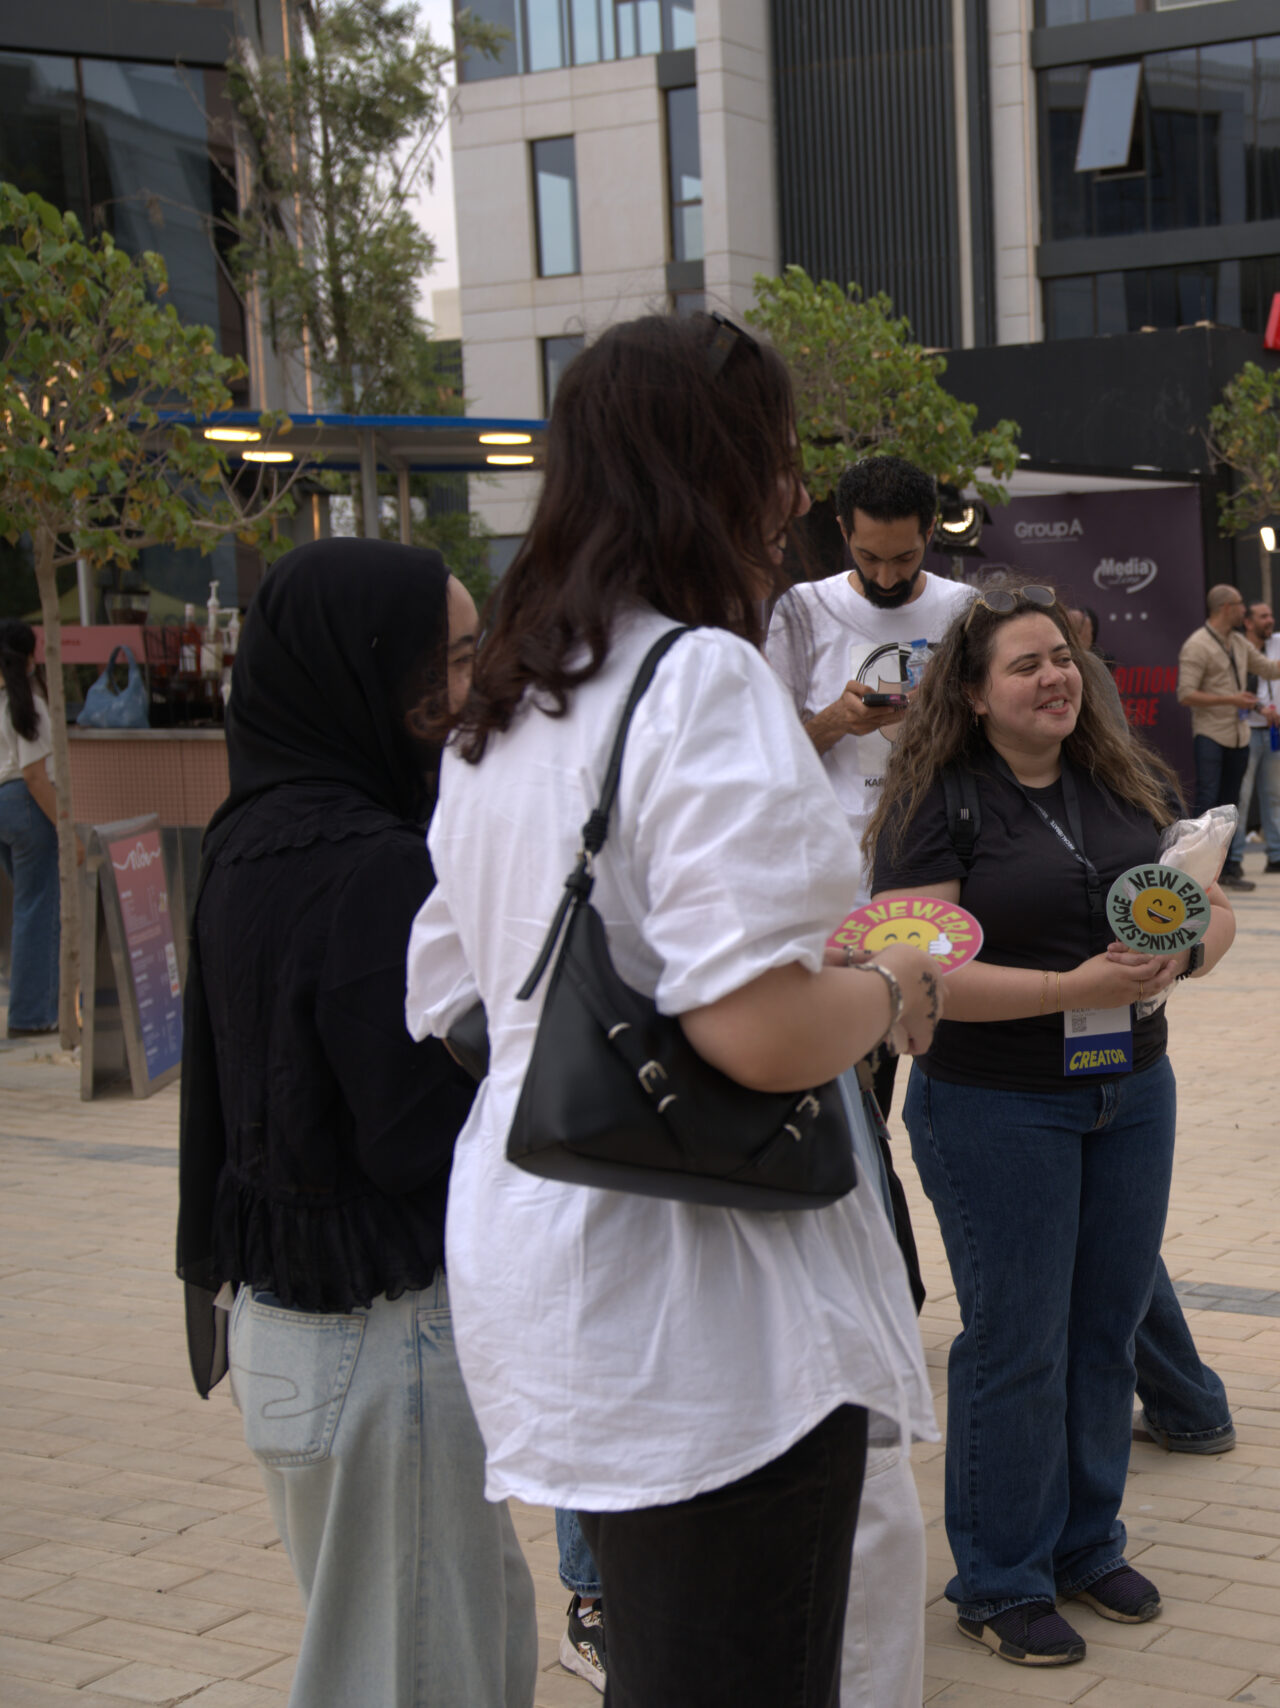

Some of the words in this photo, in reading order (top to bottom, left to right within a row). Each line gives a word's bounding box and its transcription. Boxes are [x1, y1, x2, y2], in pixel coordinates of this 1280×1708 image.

[1100, 556, 1150, 576] Media
[1113, 665, 1179, 695] DITION
[1120, 697, 1160, 727] ERE
[1128, 869, 1179, 891] NEW
[1176, 881, 1206, 919] ERA
[864, 901, 944, 924] NEW
[934, 911, 973, 943] ERA
[1112, 894, 1142, 941] STAGE
[1136, 927, 1198, 950] TAKING
[1069, 1048, 1128, 1071] CREATOR
